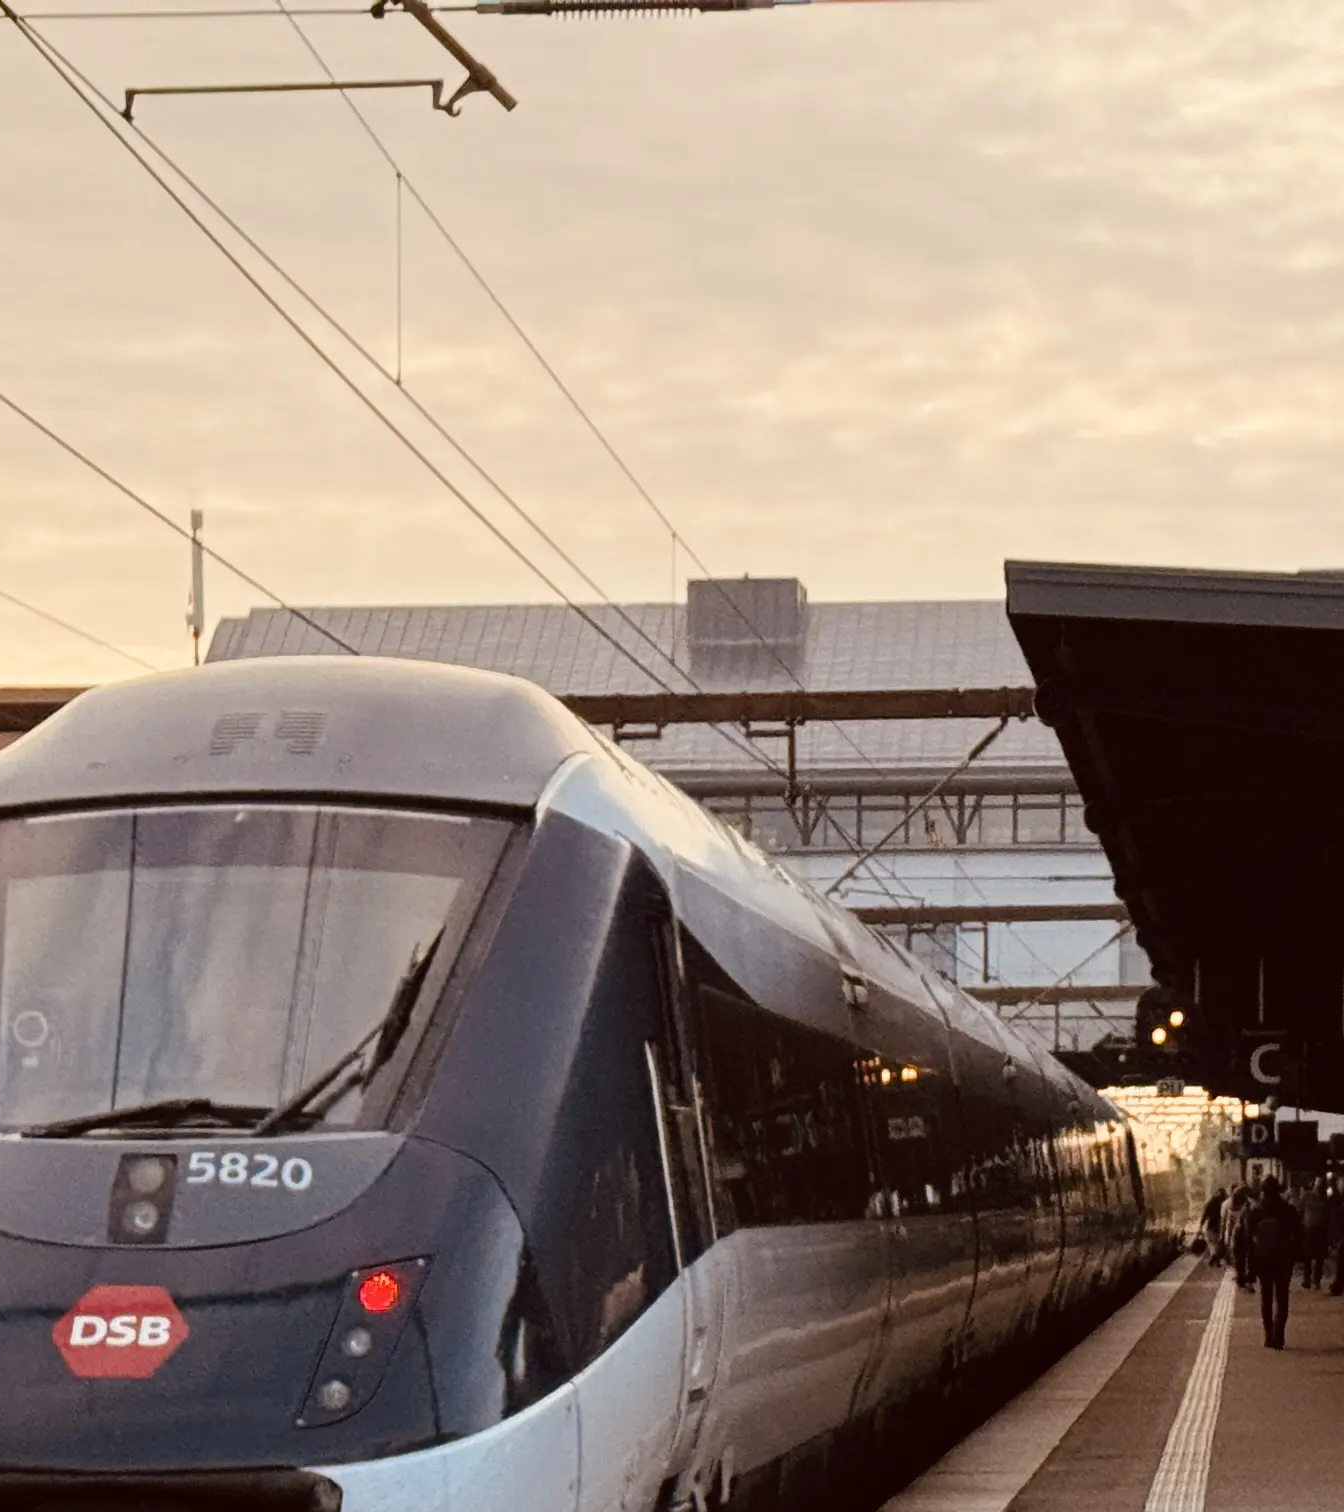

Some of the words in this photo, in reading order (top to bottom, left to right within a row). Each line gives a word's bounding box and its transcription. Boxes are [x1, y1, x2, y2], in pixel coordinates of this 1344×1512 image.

[1249, 1042, 1282, 1084] C
[1250, 1123, 1269, 1144] D
[186, 1151, 313, 1190] 5820
[69, 1314, 171, 1347] DSB
